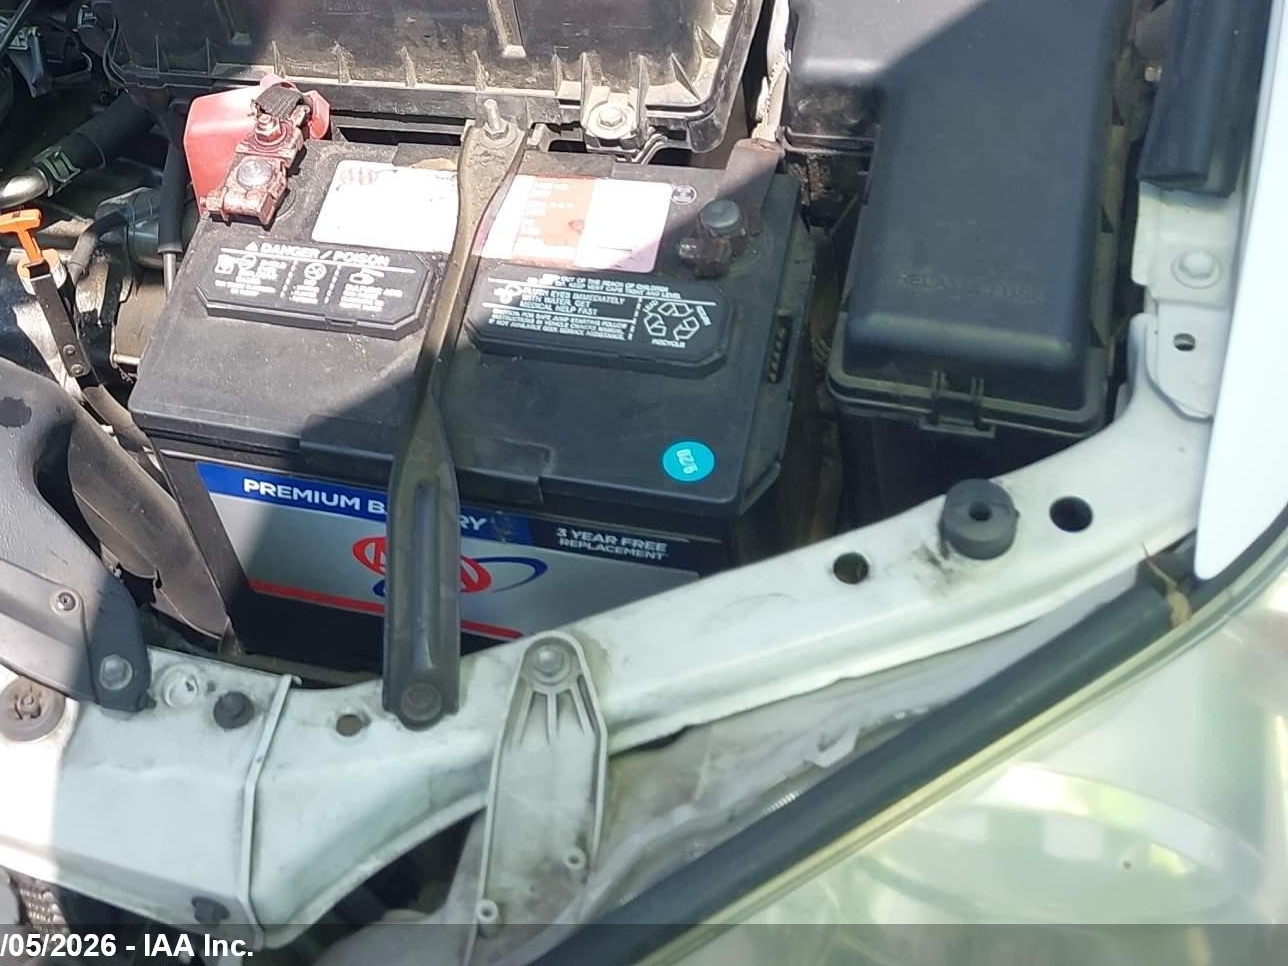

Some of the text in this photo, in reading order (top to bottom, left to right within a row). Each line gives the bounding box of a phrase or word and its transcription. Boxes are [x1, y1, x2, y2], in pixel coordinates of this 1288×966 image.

[260, 242, 320, 259] DANGER
[332, 249, 390, 267] POISON
[555, 304, 577, 313] HELP
[577, 307, 598, 316] FAST
[243, 478, 361, 511] PREMIUM
[556, 527, 668, 553] 3 YEAR FREE
[559, 537, 667, 561] REPLACEMENT
